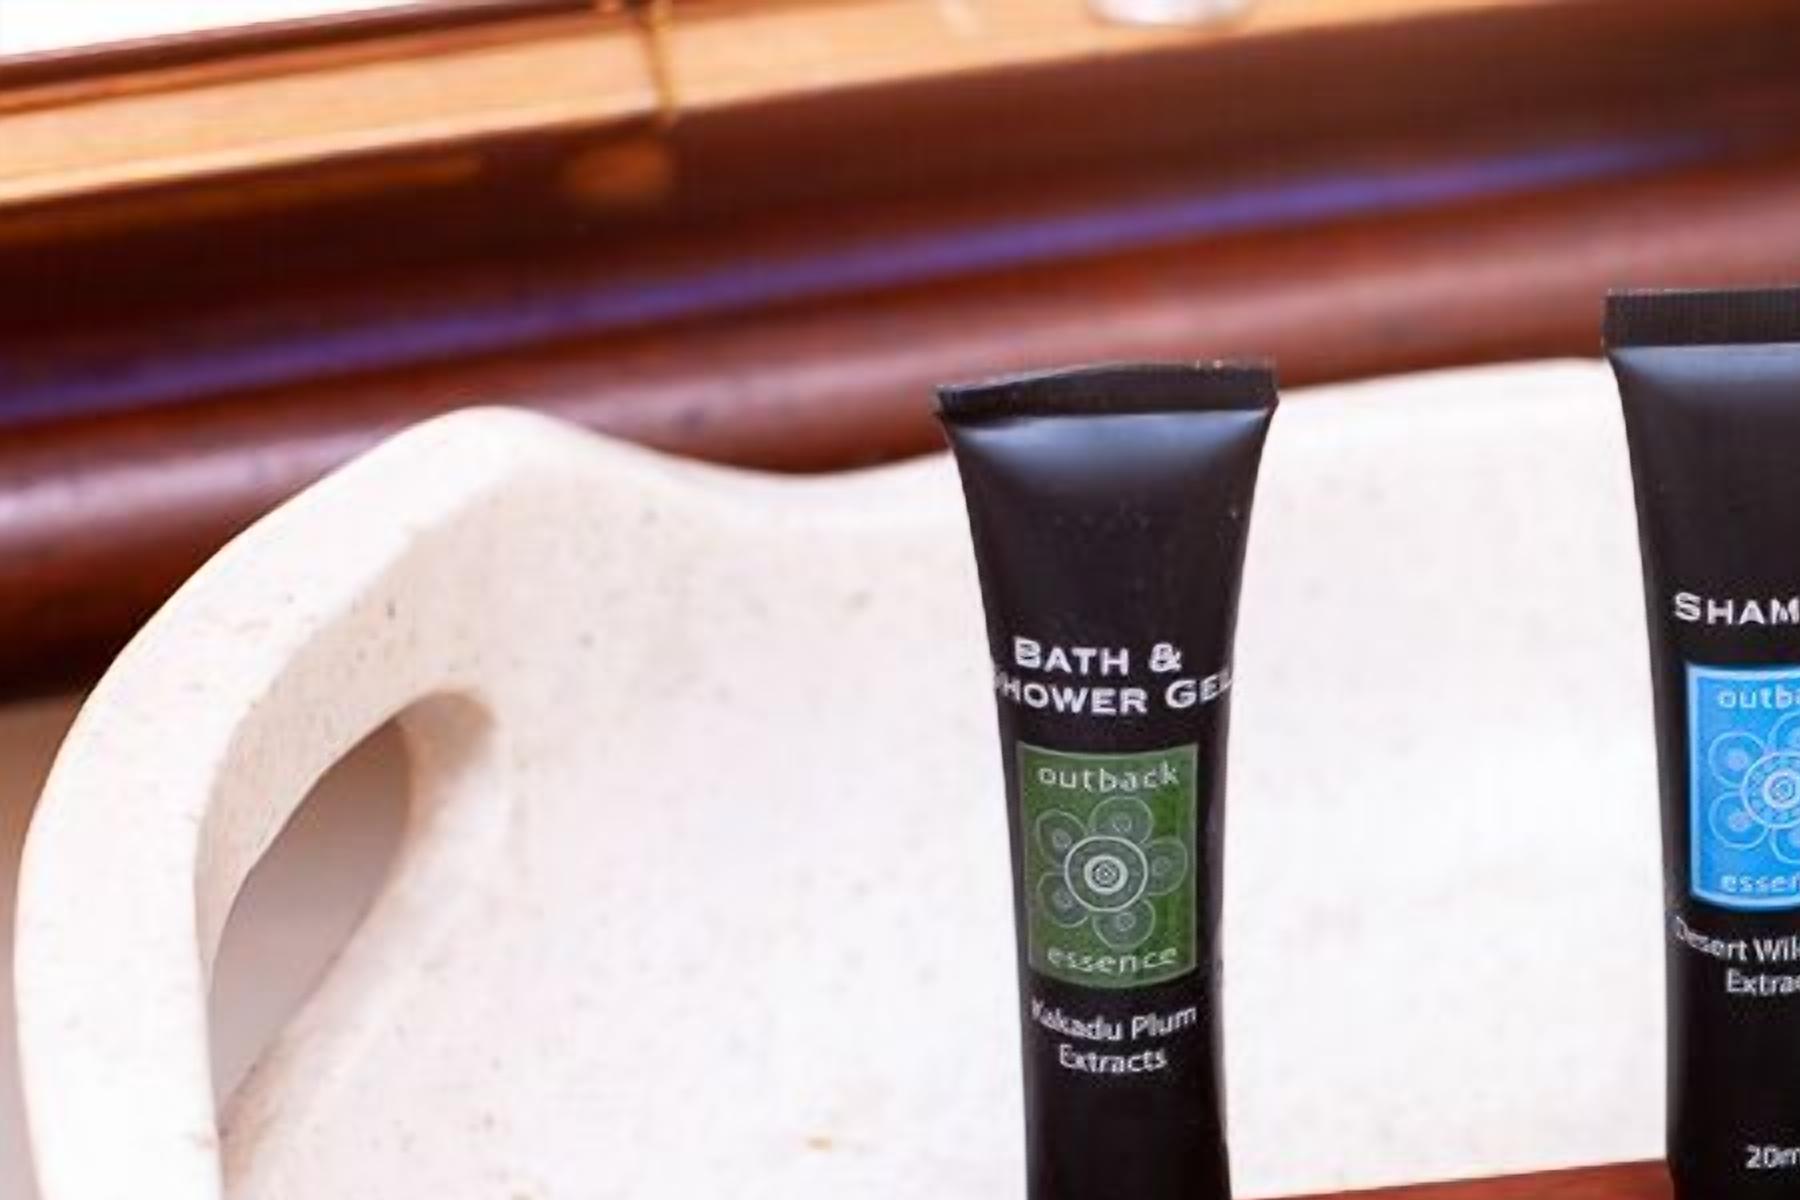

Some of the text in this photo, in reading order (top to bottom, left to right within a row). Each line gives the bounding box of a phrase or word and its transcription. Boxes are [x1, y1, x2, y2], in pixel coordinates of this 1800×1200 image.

[1013, 636, 1183, 676] BATH &
[1037, 761, 1181, 792] outback
[1047, 947, 1178, 975] essence
[1031, 995, 1198, 1042] Kakadu Plum
[1059, 1043, 1169, 1074] Extracts
